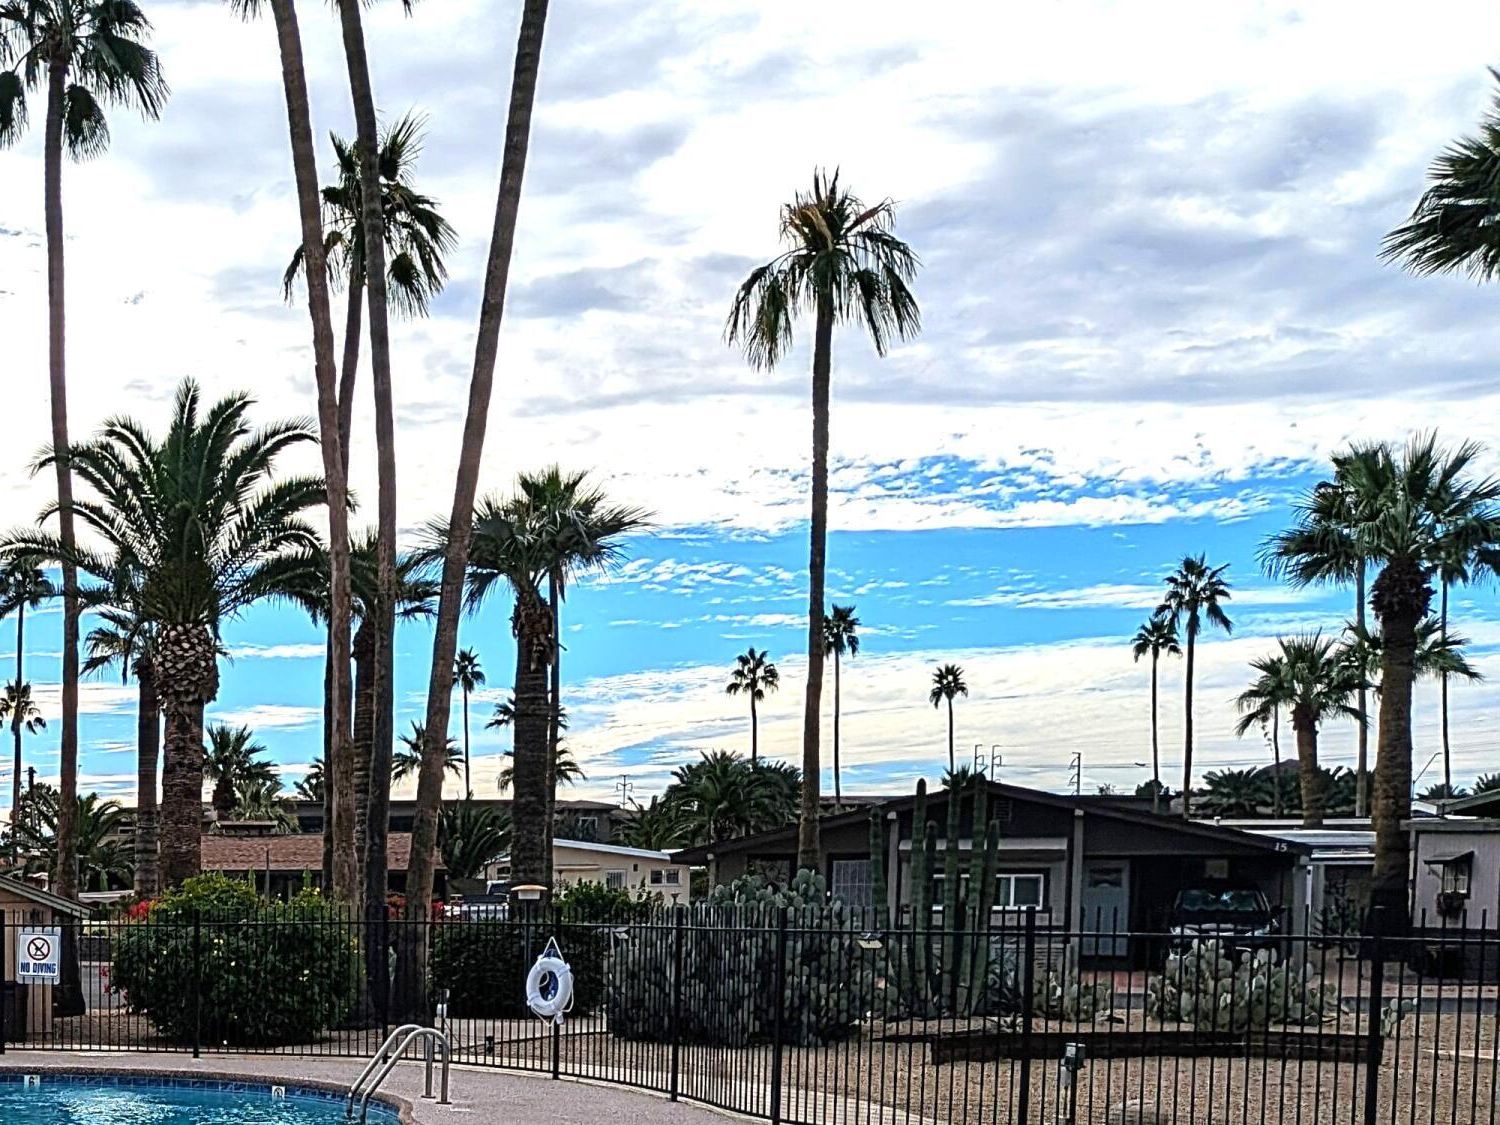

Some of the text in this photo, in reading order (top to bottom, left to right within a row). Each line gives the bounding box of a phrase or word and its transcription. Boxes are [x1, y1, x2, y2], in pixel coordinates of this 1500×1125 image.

[1275, 842, 1287, 852] 15
[20, 962, 57, 974] NO DIVING
